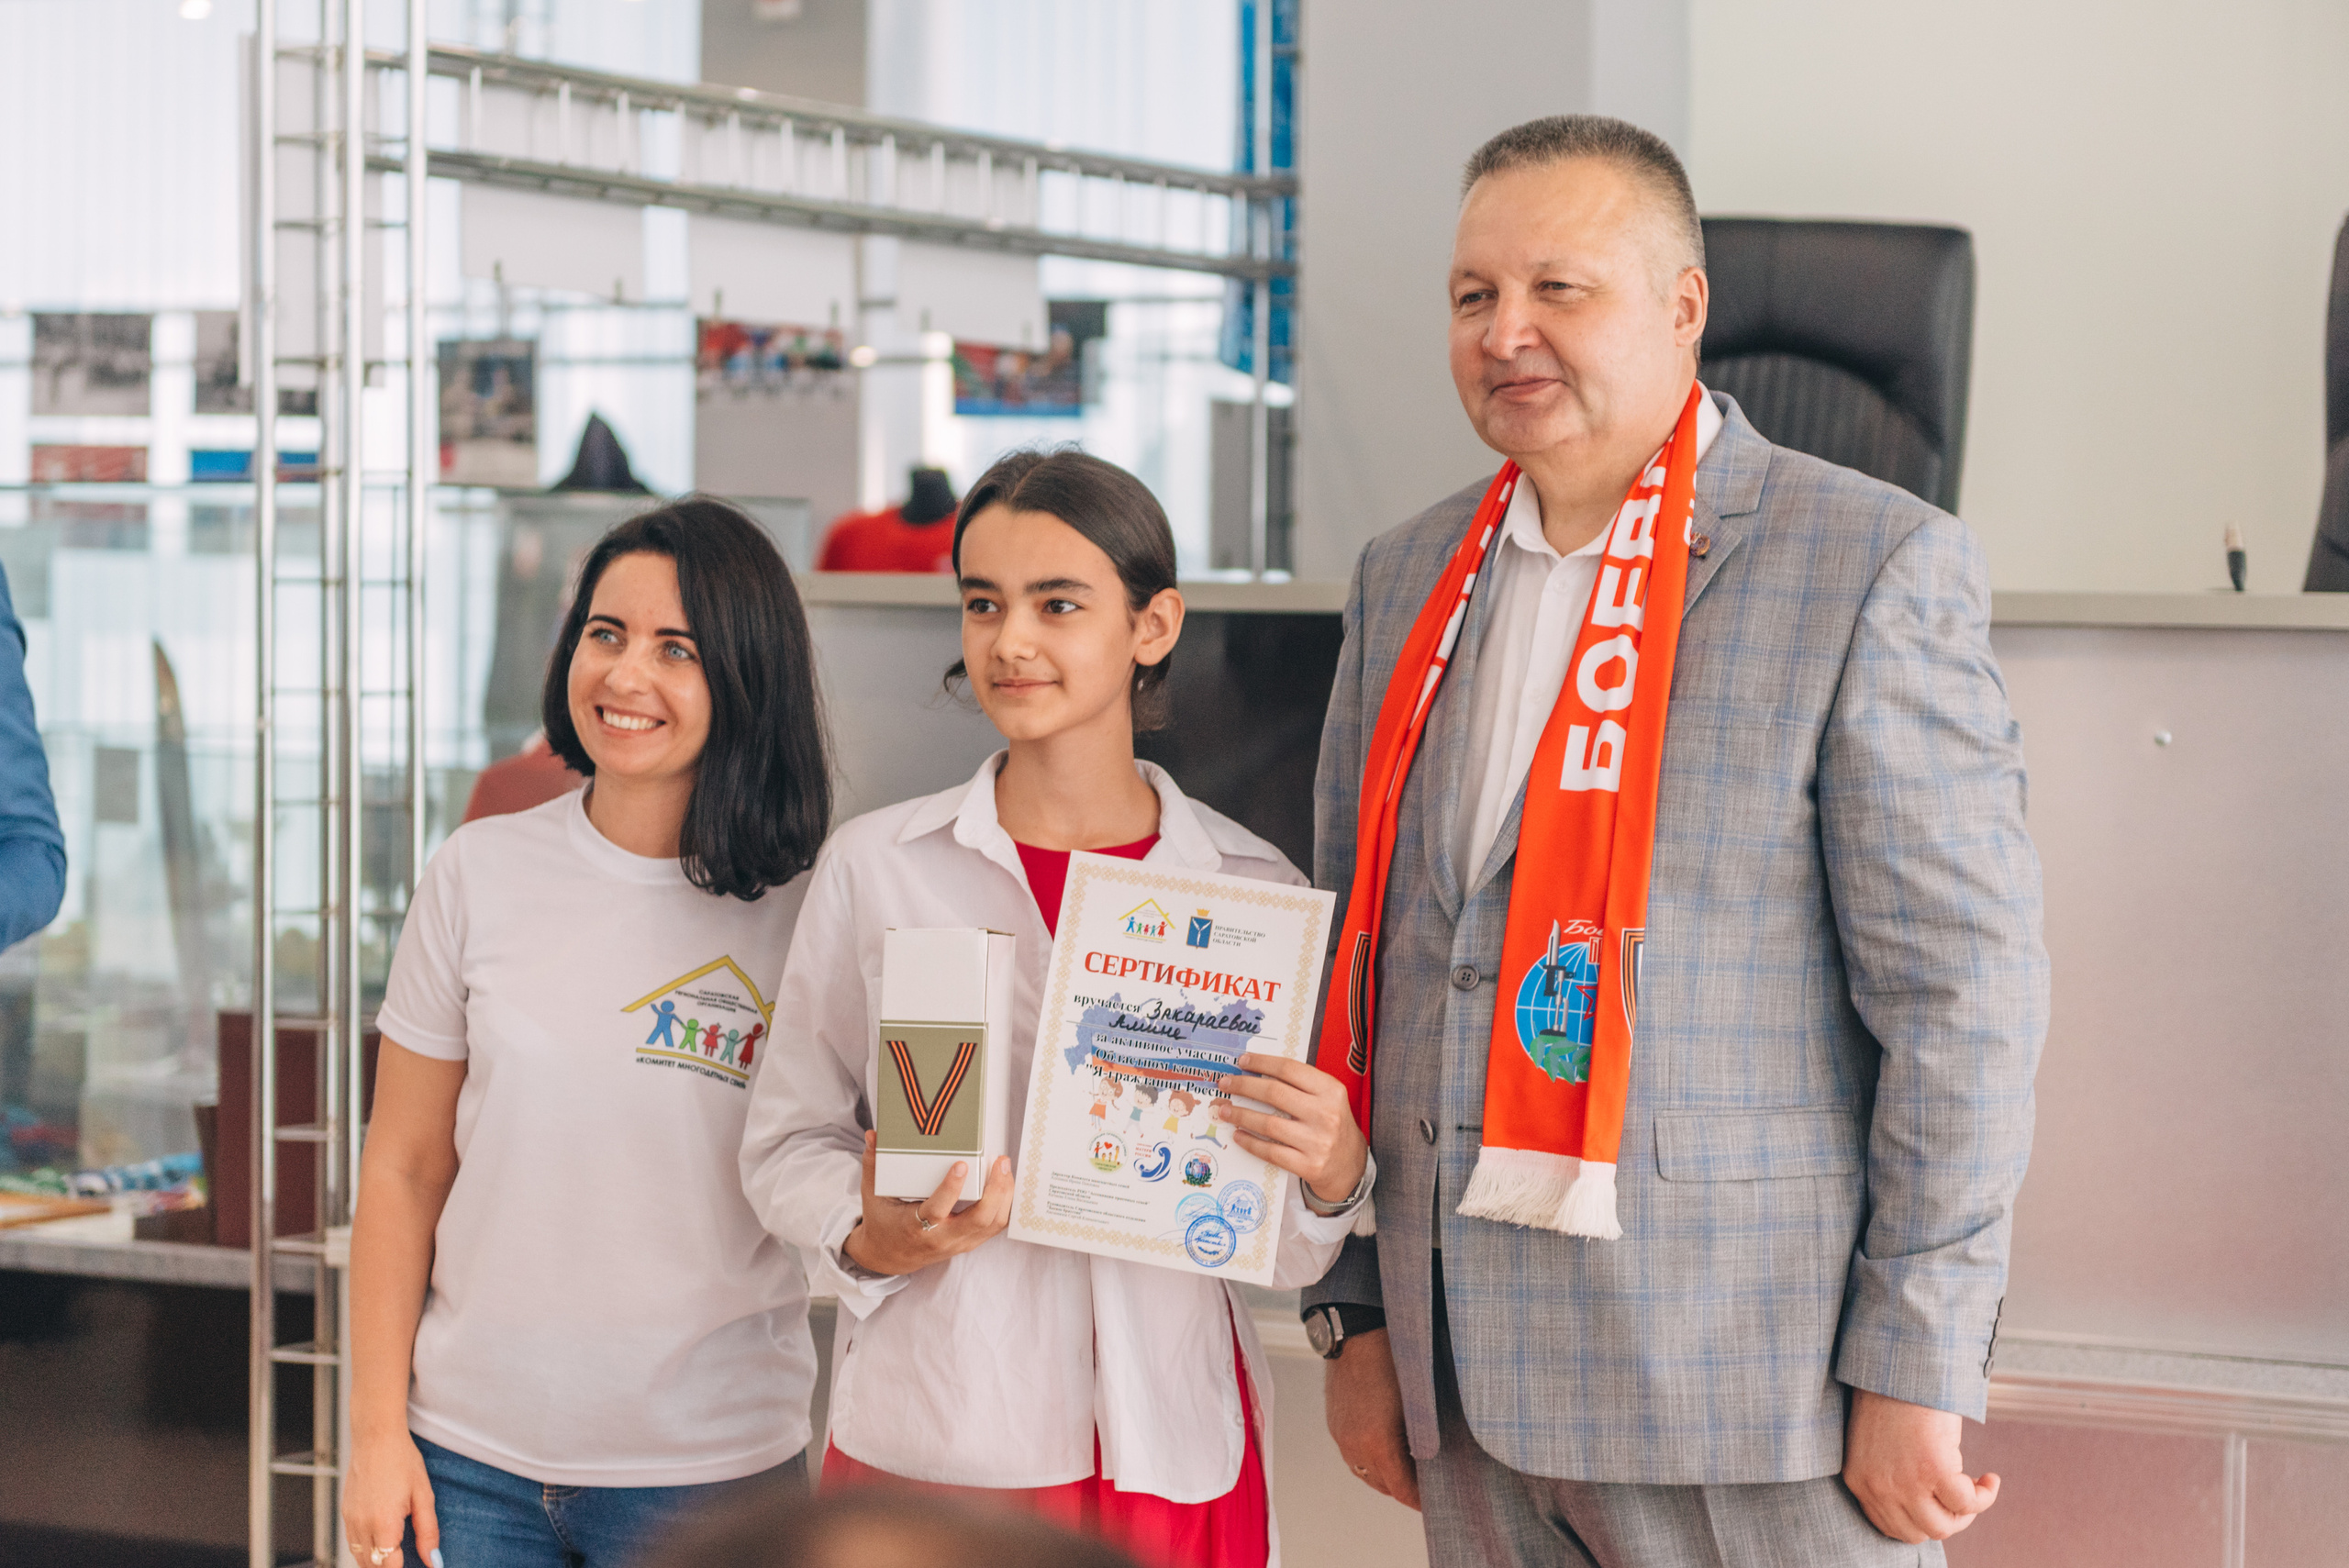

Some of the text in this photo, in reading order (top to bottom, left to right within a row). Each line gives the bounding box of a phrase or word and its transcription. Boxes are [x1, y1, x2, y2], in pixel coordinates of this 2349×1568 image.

[1560, 445, 1666, 792] БОЕВ
[1212, 938, 1241, 947] ОБЛАСТИ
[1213, 931, 1257, 943] САРАТОВСКОЙ
[1215, 925, 1266, 938] ПРАВИТЕЛЬСТВО
[1084, 951, 1281, 1003] СЕРТИФИКАТ
[1074, 994, 1141, 1014] вручается
[1108, 1015, 1187, 1040] Амине
[1095, 1032, 1108, 1043] за
[1111, 1036, 1174, 1055] активное
[1176, 1048, 1230, 1065] участие
[1096, 1048, 1169, 1072] Областном
[885, 1040, 977, 1136] V
